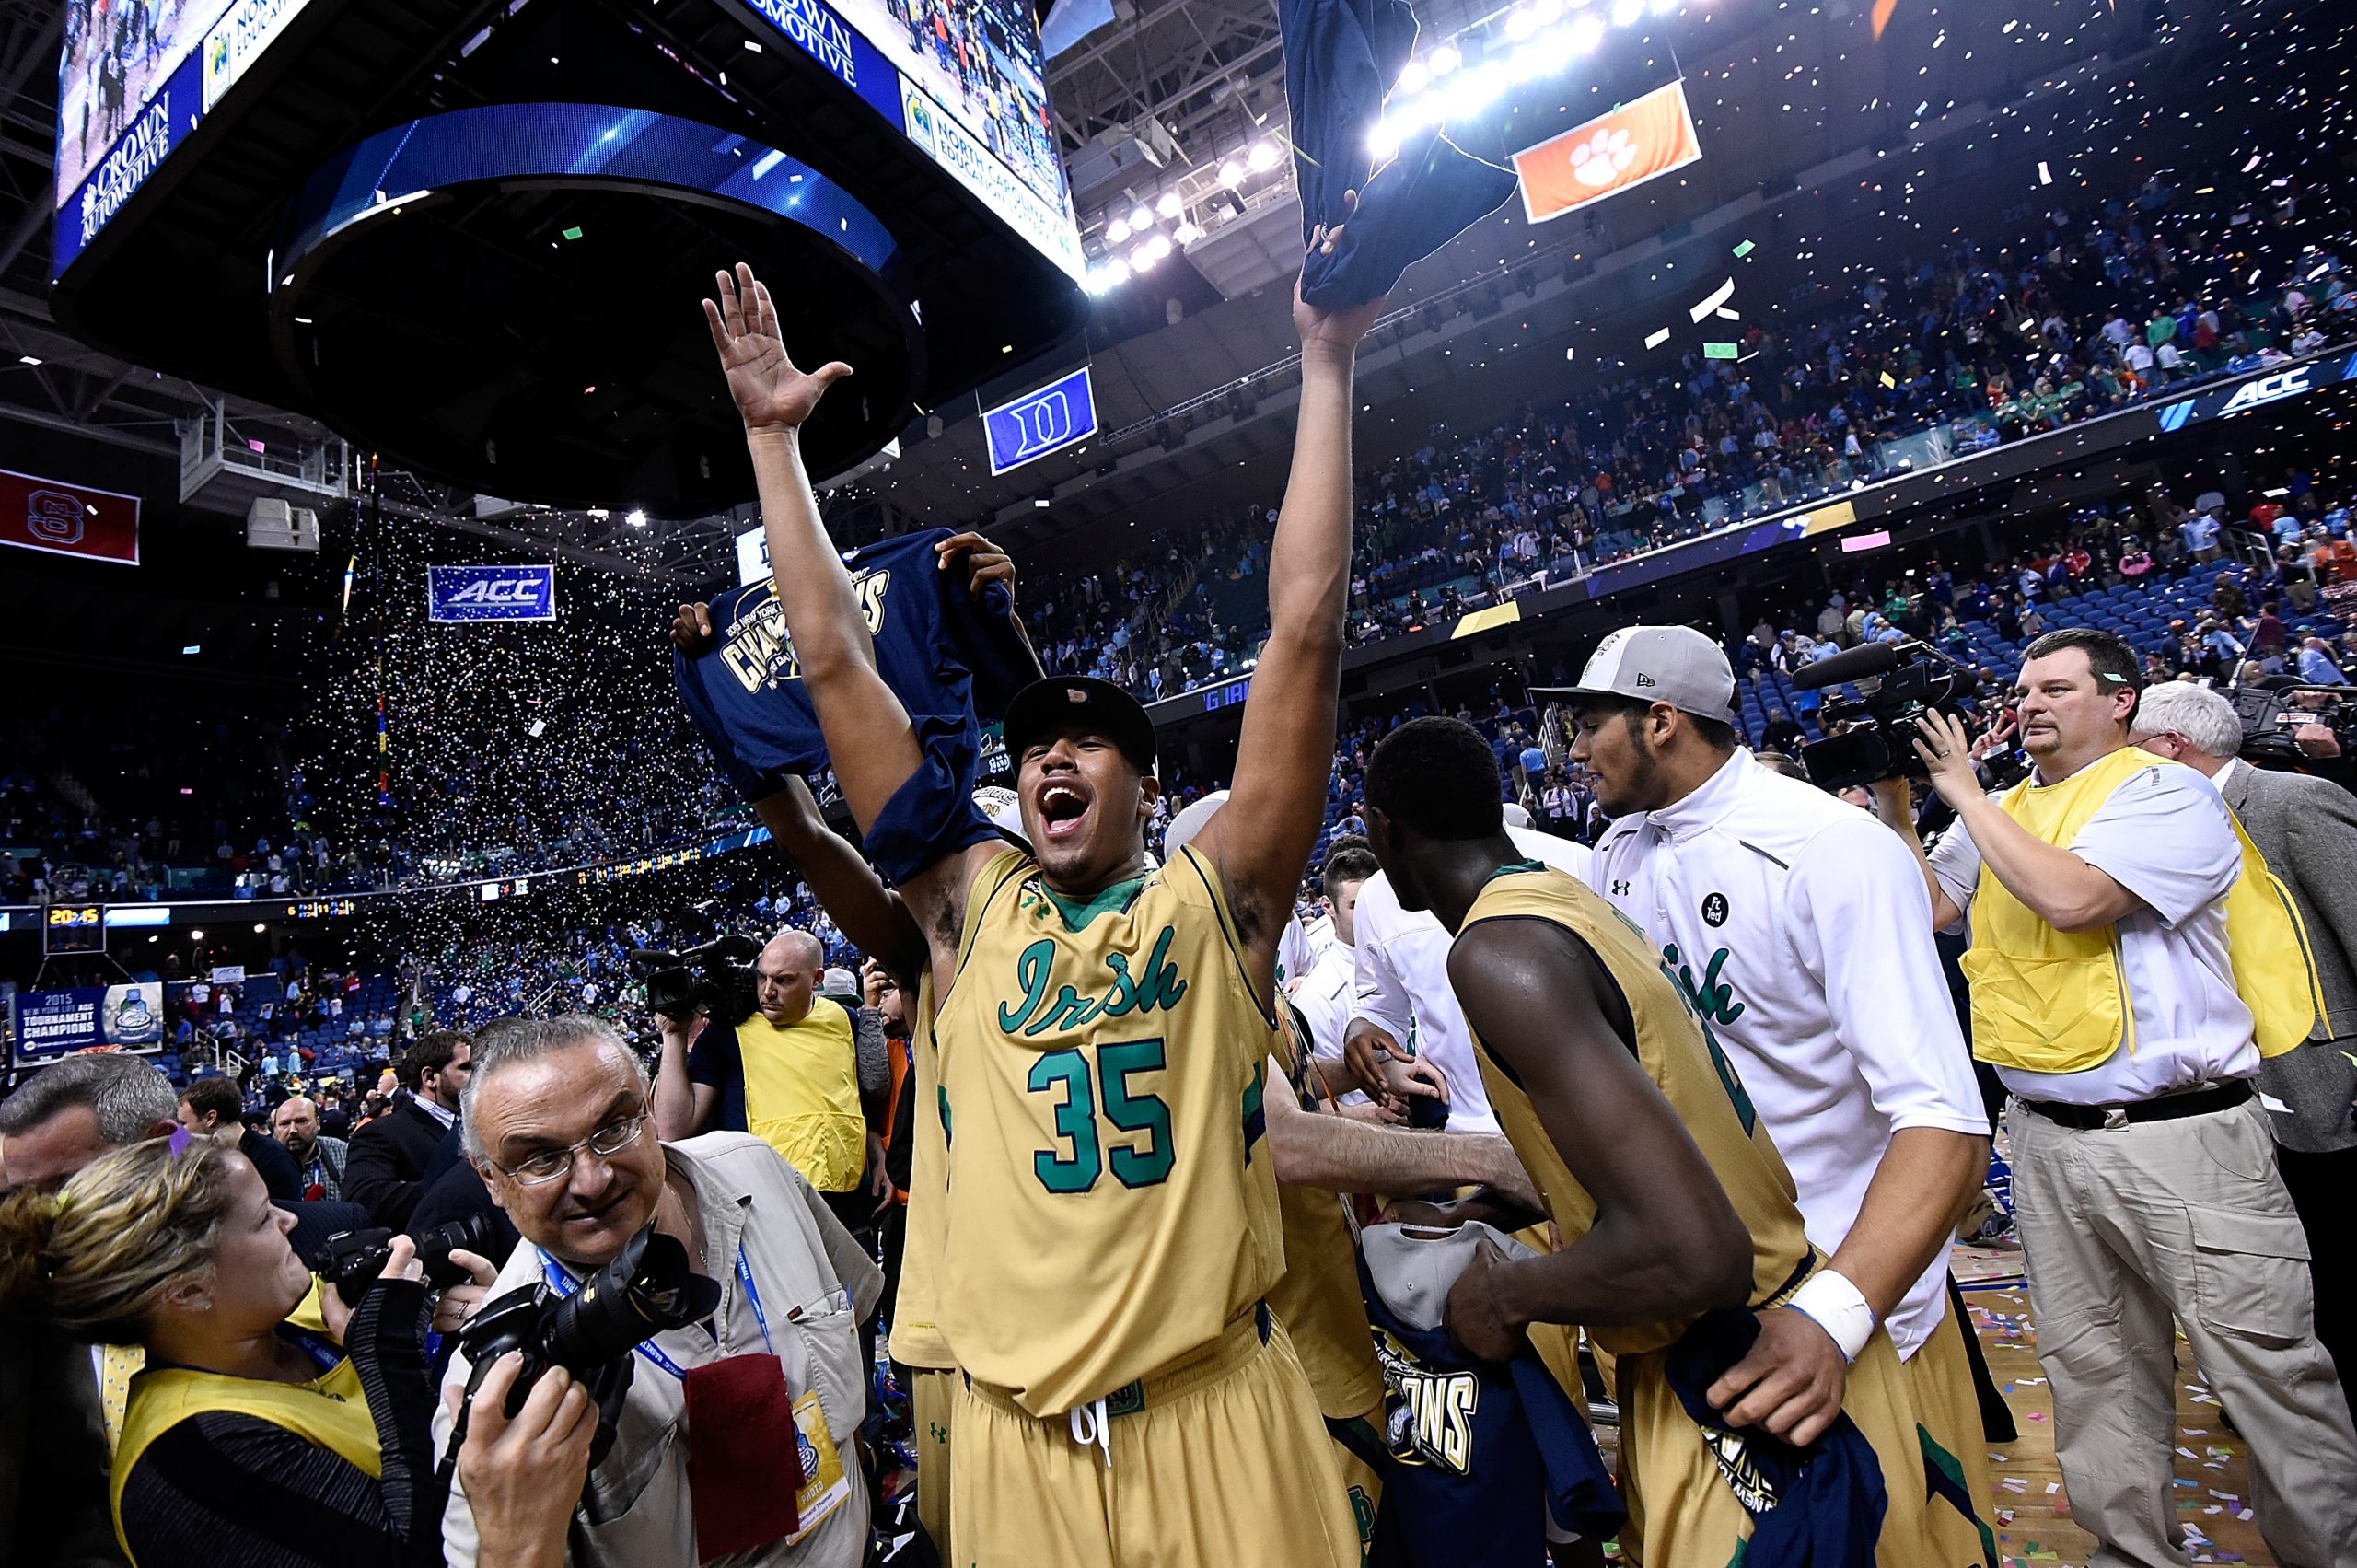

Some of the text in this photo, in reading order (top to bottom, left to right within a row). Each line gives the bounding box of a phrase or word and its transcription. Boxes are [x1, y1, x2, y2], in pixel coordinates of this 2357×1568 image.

[98, 90, 170, 197] CROWN
[937, 117, 984, 172] NORTH
[80, 127, 170, 248] AUTOMOTIVE
[2222, 366, 2310, 410] ACC
[447, 579, 544, 603] ACC
[739, 610, 758, 630] NEW
[757, 604, 778, 621] YORK
[1707, 906, 1723, 923] Ted
[998, 925, 1188, 1037] Irish
[45, 993, 73, 1006] 2015
[77, 1003, 95, 1012] ACC
[23, 1011, 95, 1028] TOURNAMENT
[23, 1021, 95, 1039] CHAMPIONS
[1027, 1038, 1177, 1194] 35
[800, 1480, 824, 1504] PHOTO
